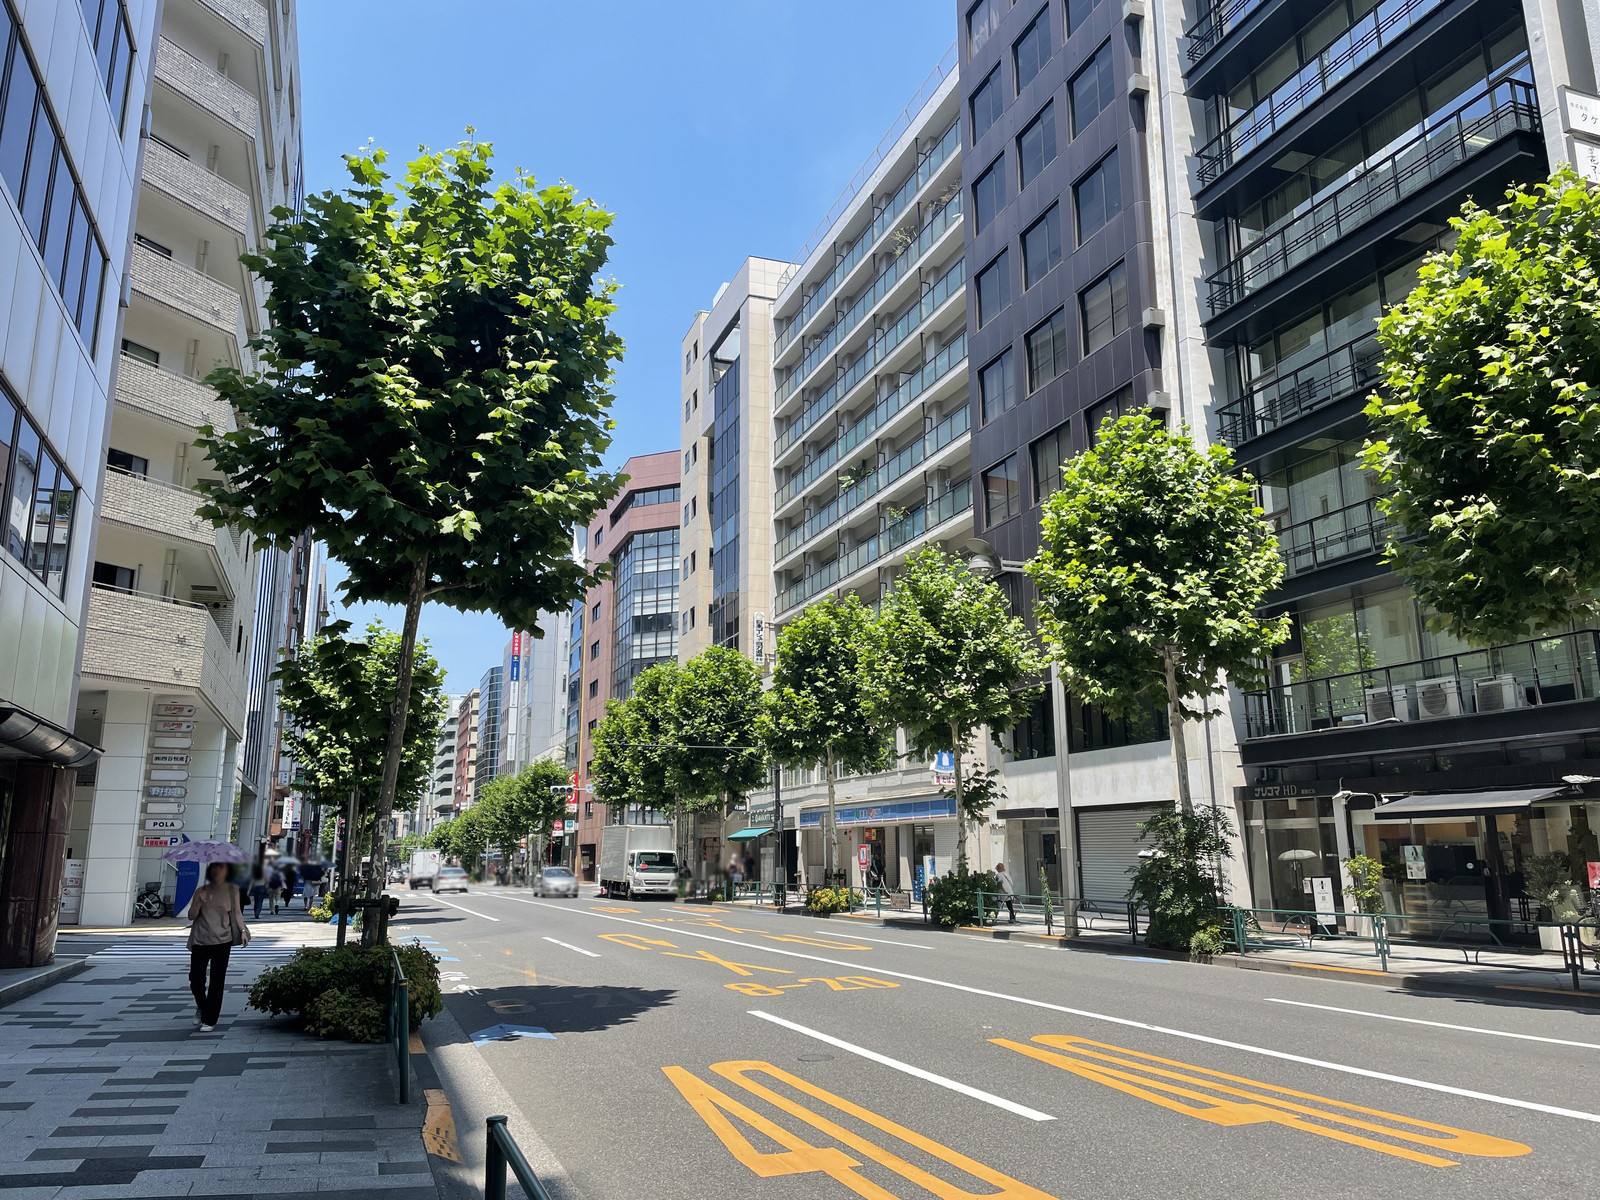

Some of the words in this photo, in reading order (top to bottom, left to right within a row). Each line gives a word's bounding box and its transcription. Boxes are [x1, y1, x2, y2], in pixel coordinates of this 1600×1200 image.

[1283, 785, 1297, 796] HD
[170, 837, 179, 846] P
[723, 976, 901, 996] 8-20
[986, 1034, 1534, 1169] 40
[660, 1060, 1063, 1200] 40
